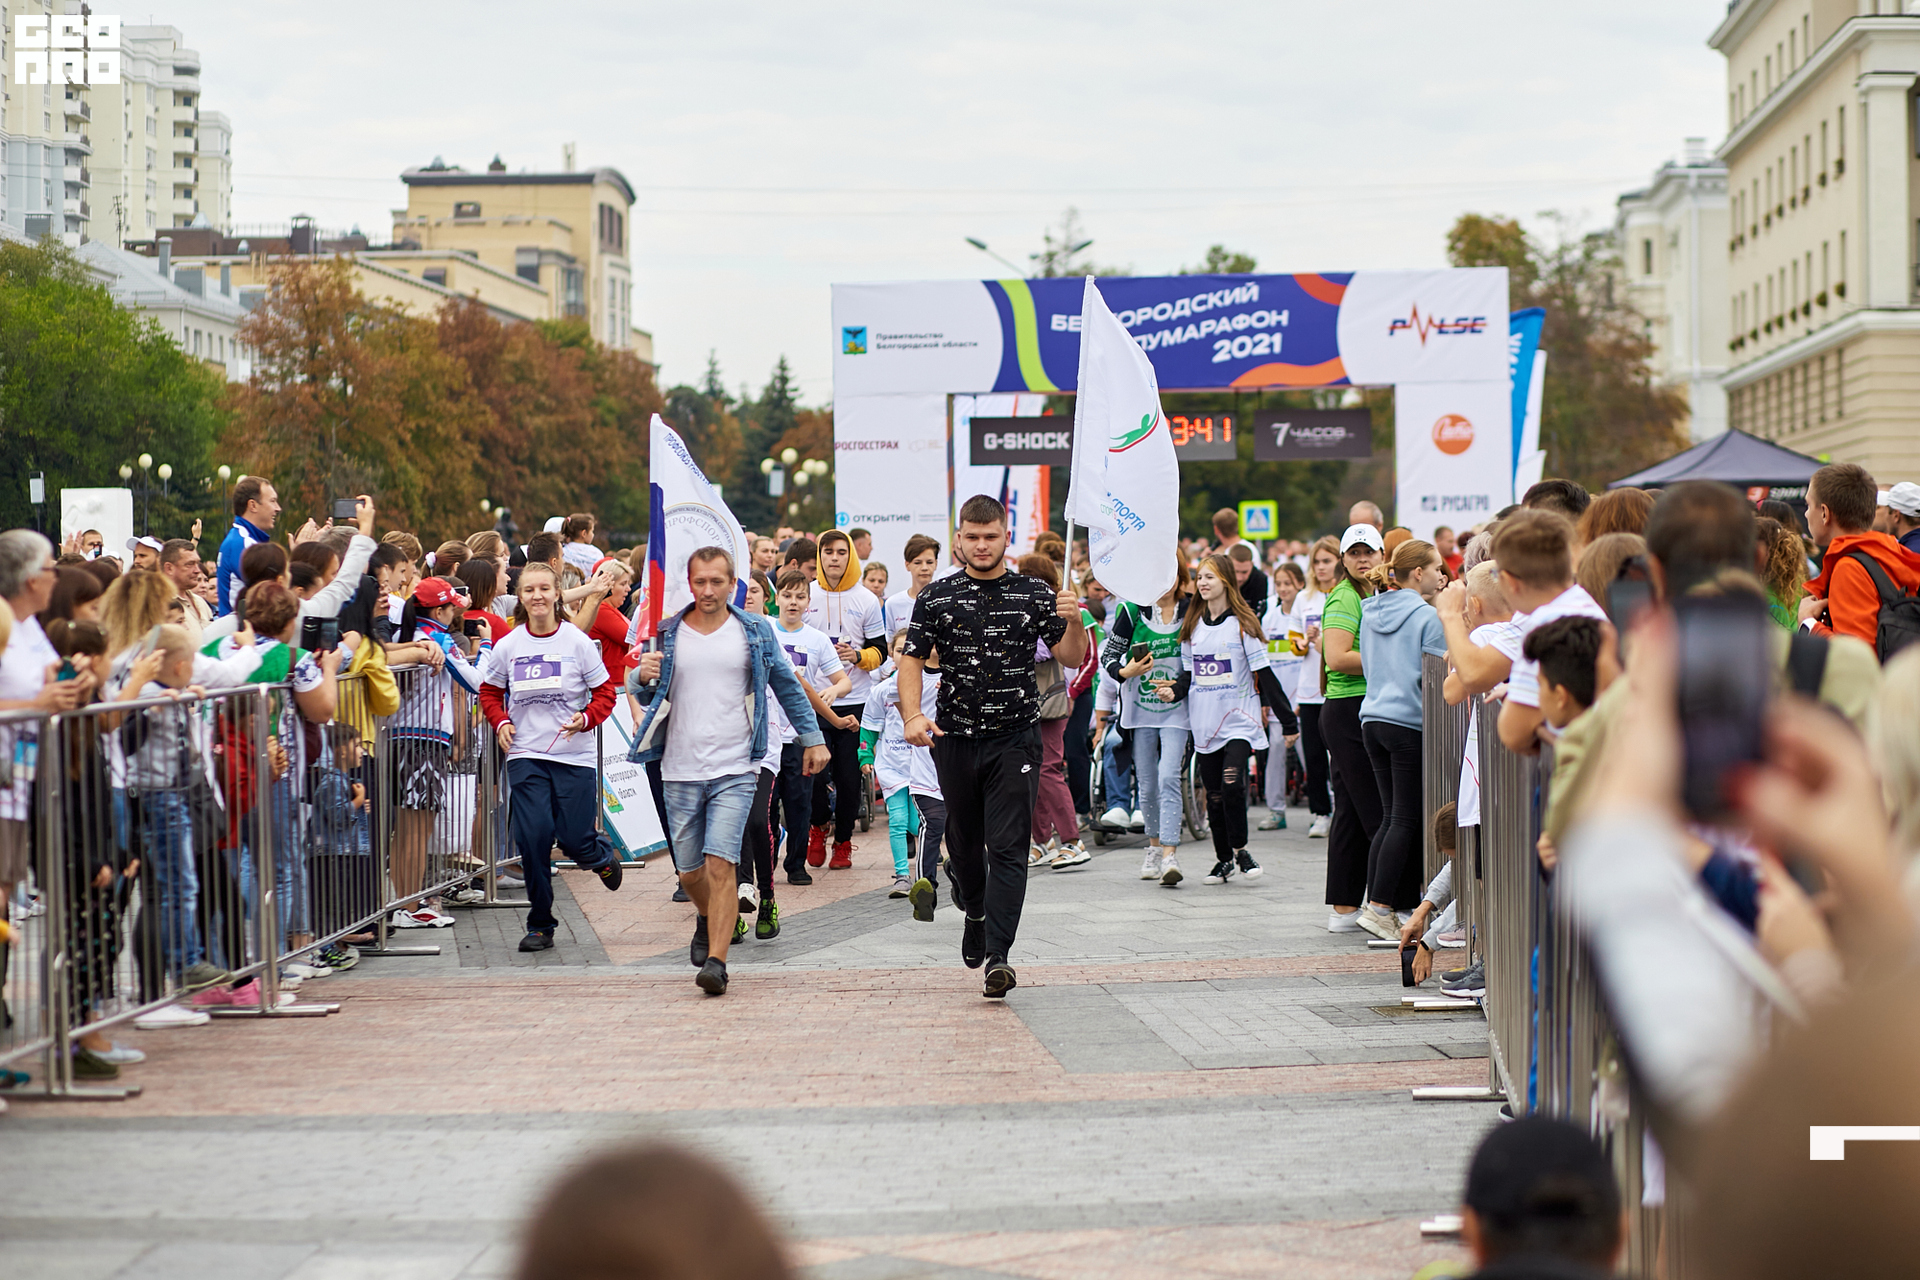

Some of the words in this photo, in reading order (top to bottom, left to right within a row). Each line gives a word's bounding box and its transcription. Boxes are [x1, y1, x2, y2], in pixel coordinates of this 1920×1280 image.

[1051, 282, 1260, 333] БЕОРОДСКИЙ
[1212, 332, 1283, 364] 2021
[835, 440, 899, 451] РОСГОССТРАХ
[983, 432, 1071, 450] G-SHOCK
[852, 514, 911, 524] открытие
[524, 664, 541, 679] 16
[1199, 662, 1219, 675] 30
